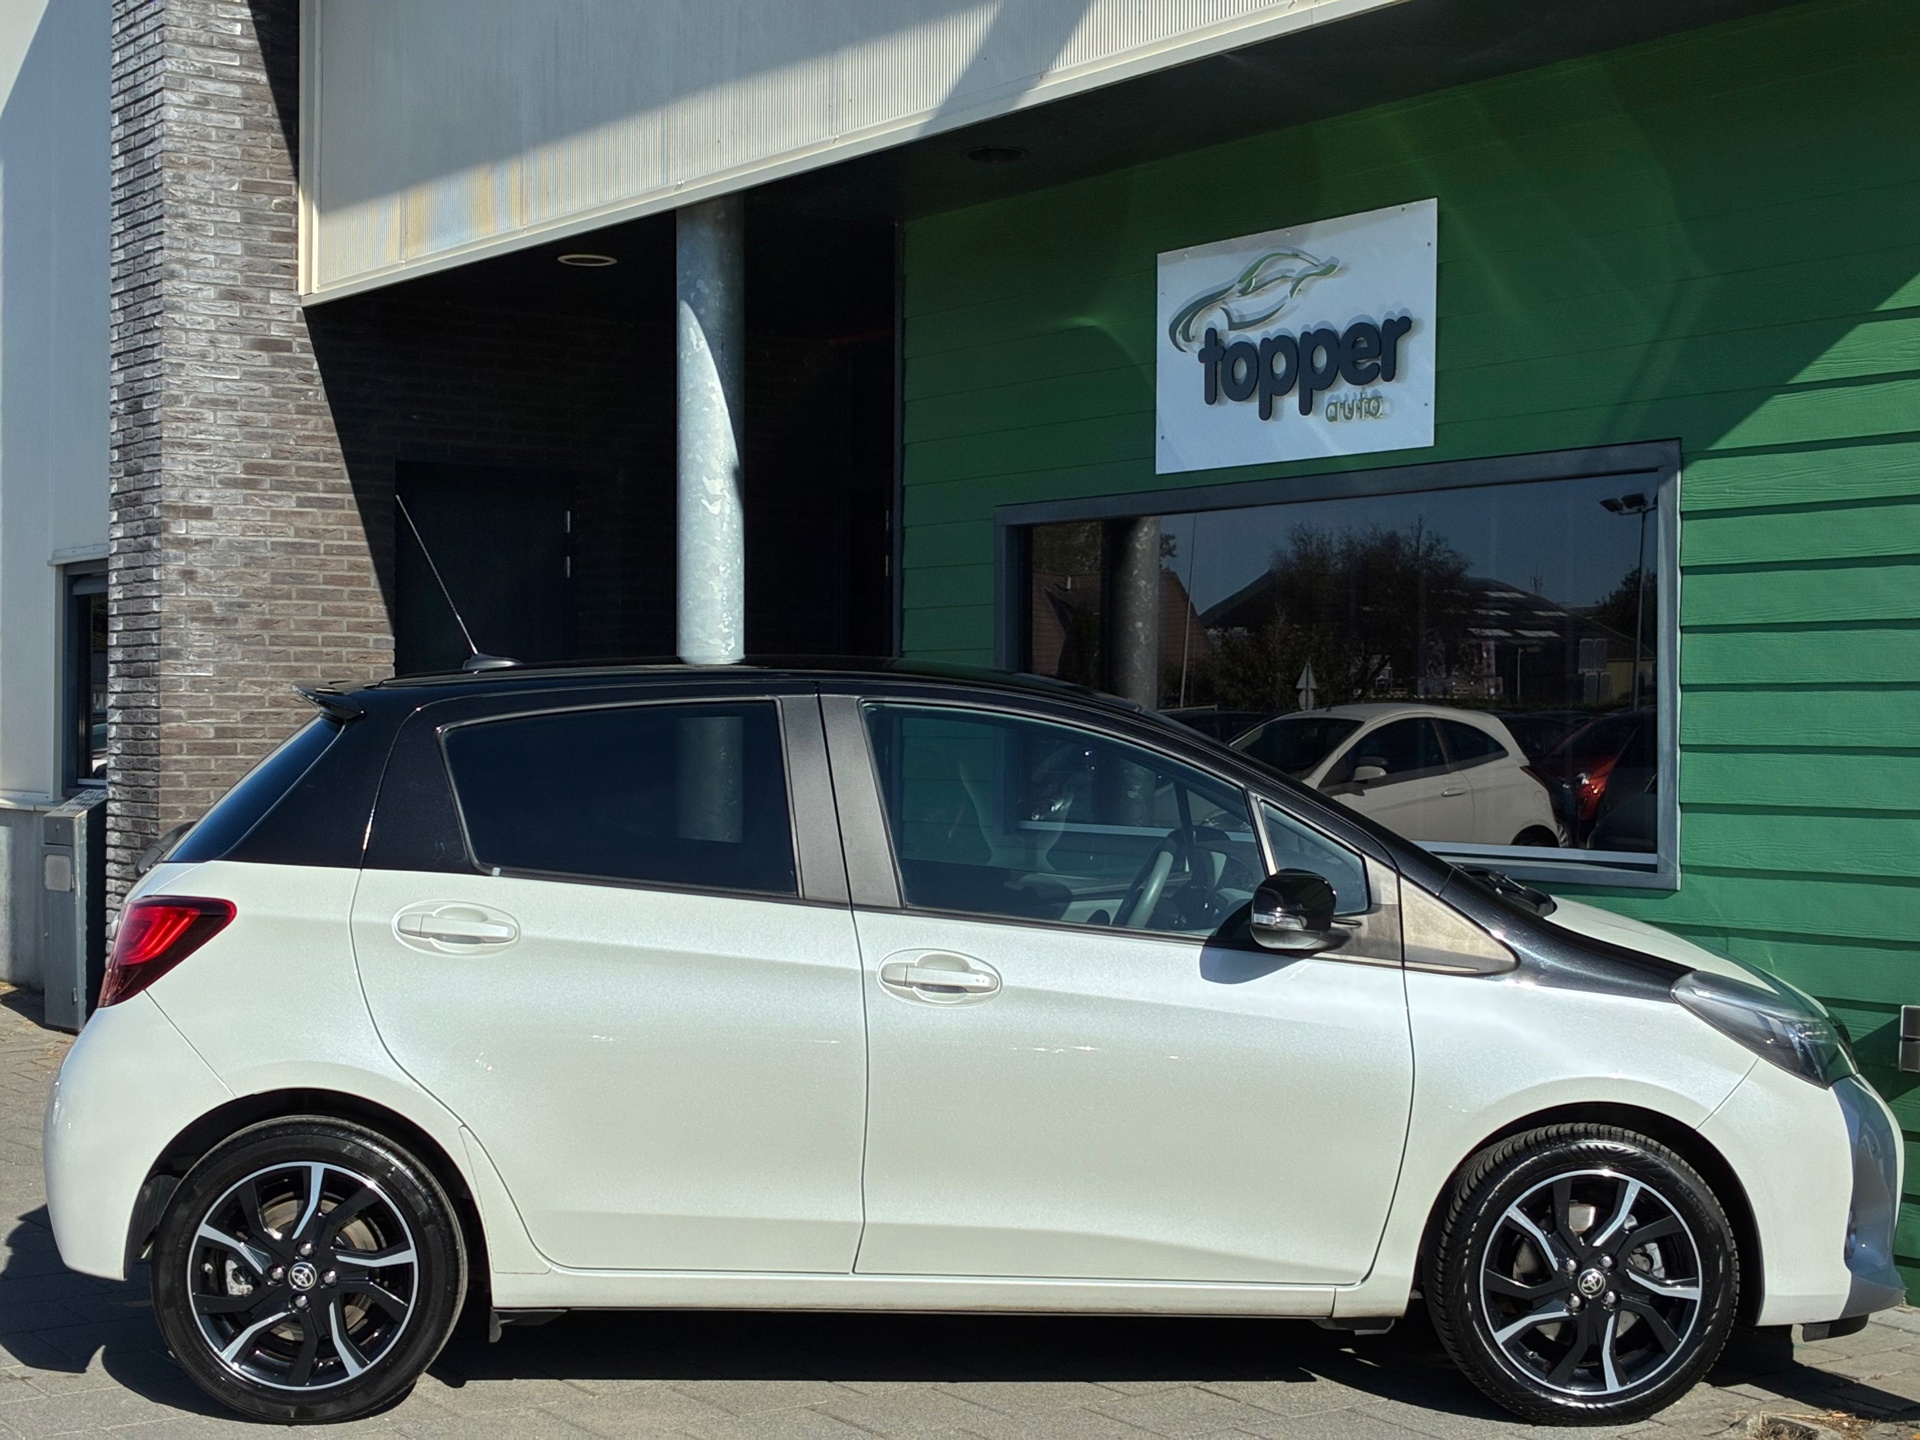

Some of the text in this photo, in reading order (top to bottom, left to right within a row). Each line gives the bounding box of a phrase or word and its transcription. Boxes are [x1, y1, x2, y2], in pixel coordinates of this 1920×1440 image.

[1198, 315, 1412, 421] topper
[1325, 393, 1382, 422] auto
[1675, 1182, 1715, 1234] QUATRAC
